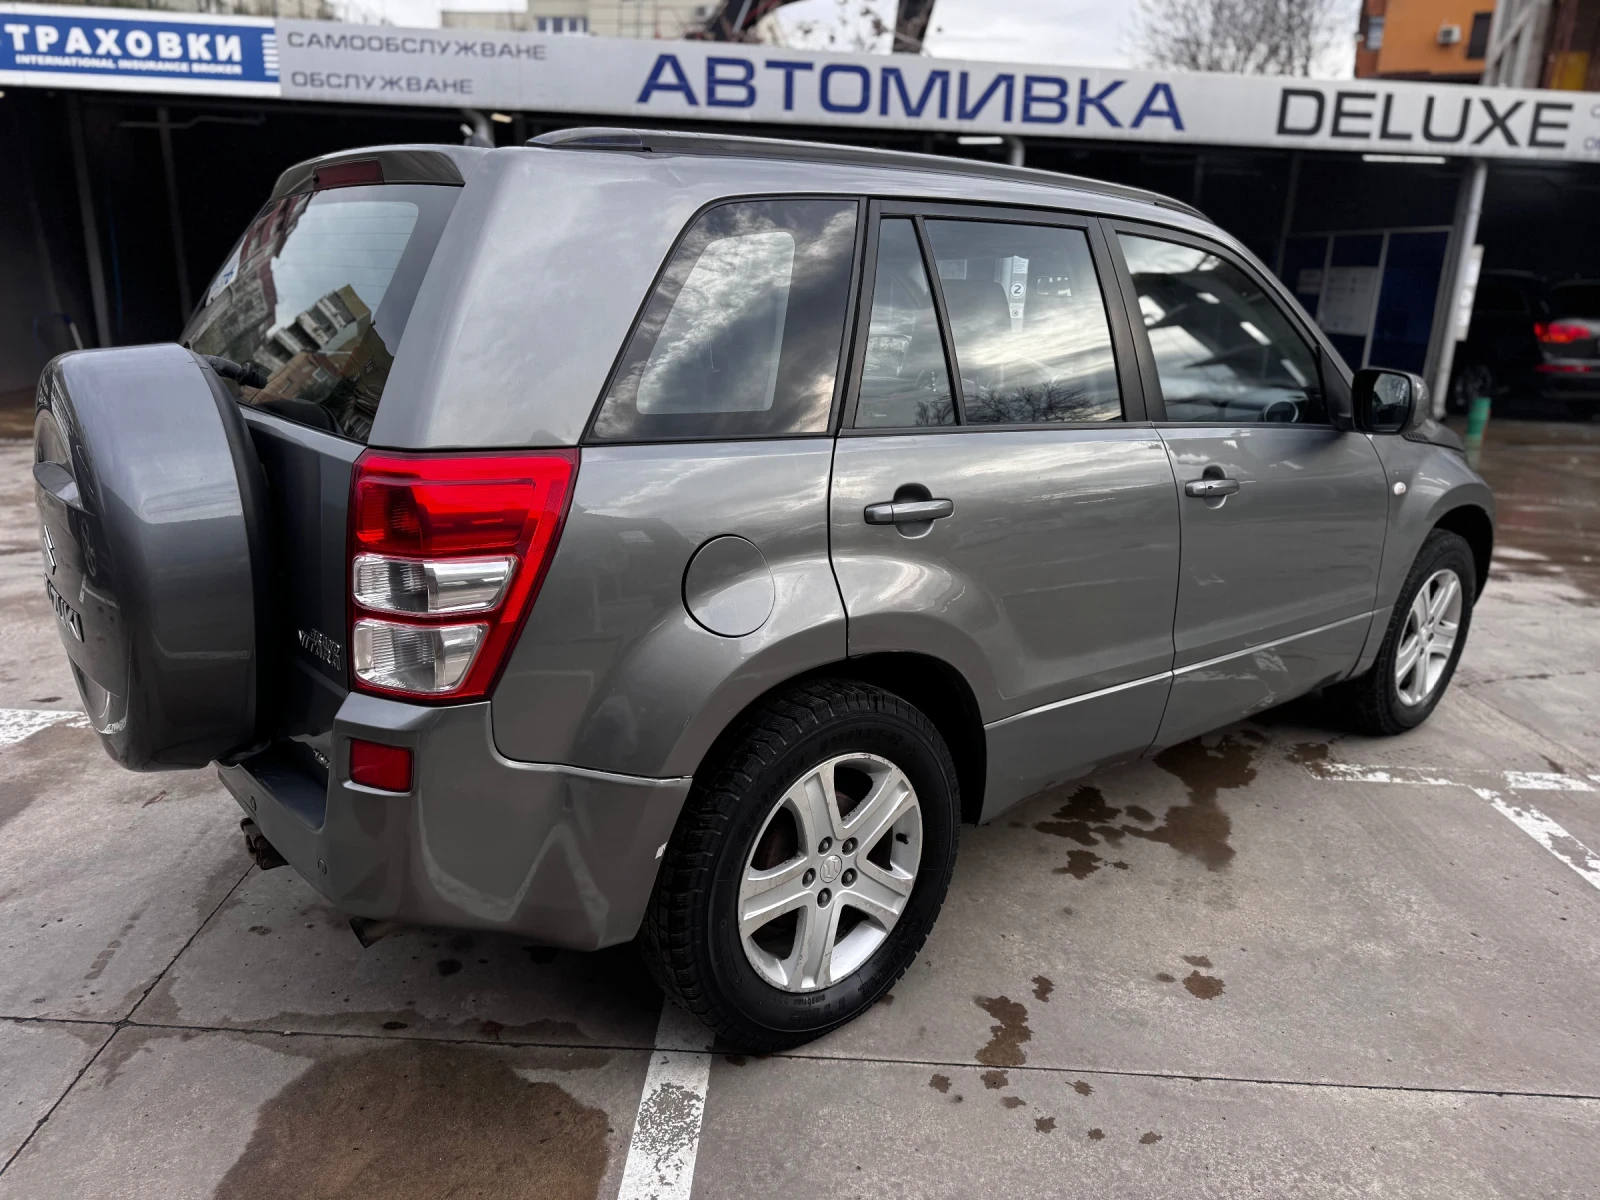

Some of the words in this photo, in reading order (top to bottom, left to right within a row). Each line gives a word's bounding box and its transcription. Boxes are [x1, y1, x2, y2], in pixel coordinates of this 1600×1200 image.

[0, 24, 243, 62] ТРАХОВКИ
[15, 54, 117, 69] INTERNATIONAL
[118, 59, 190, 73] INSURANCE
[191, 62, 243, 75] BROKER
[637, 53, 1185, 131] АВТОМИВКА
[1275, 87, 1574, 149] DELUXE
